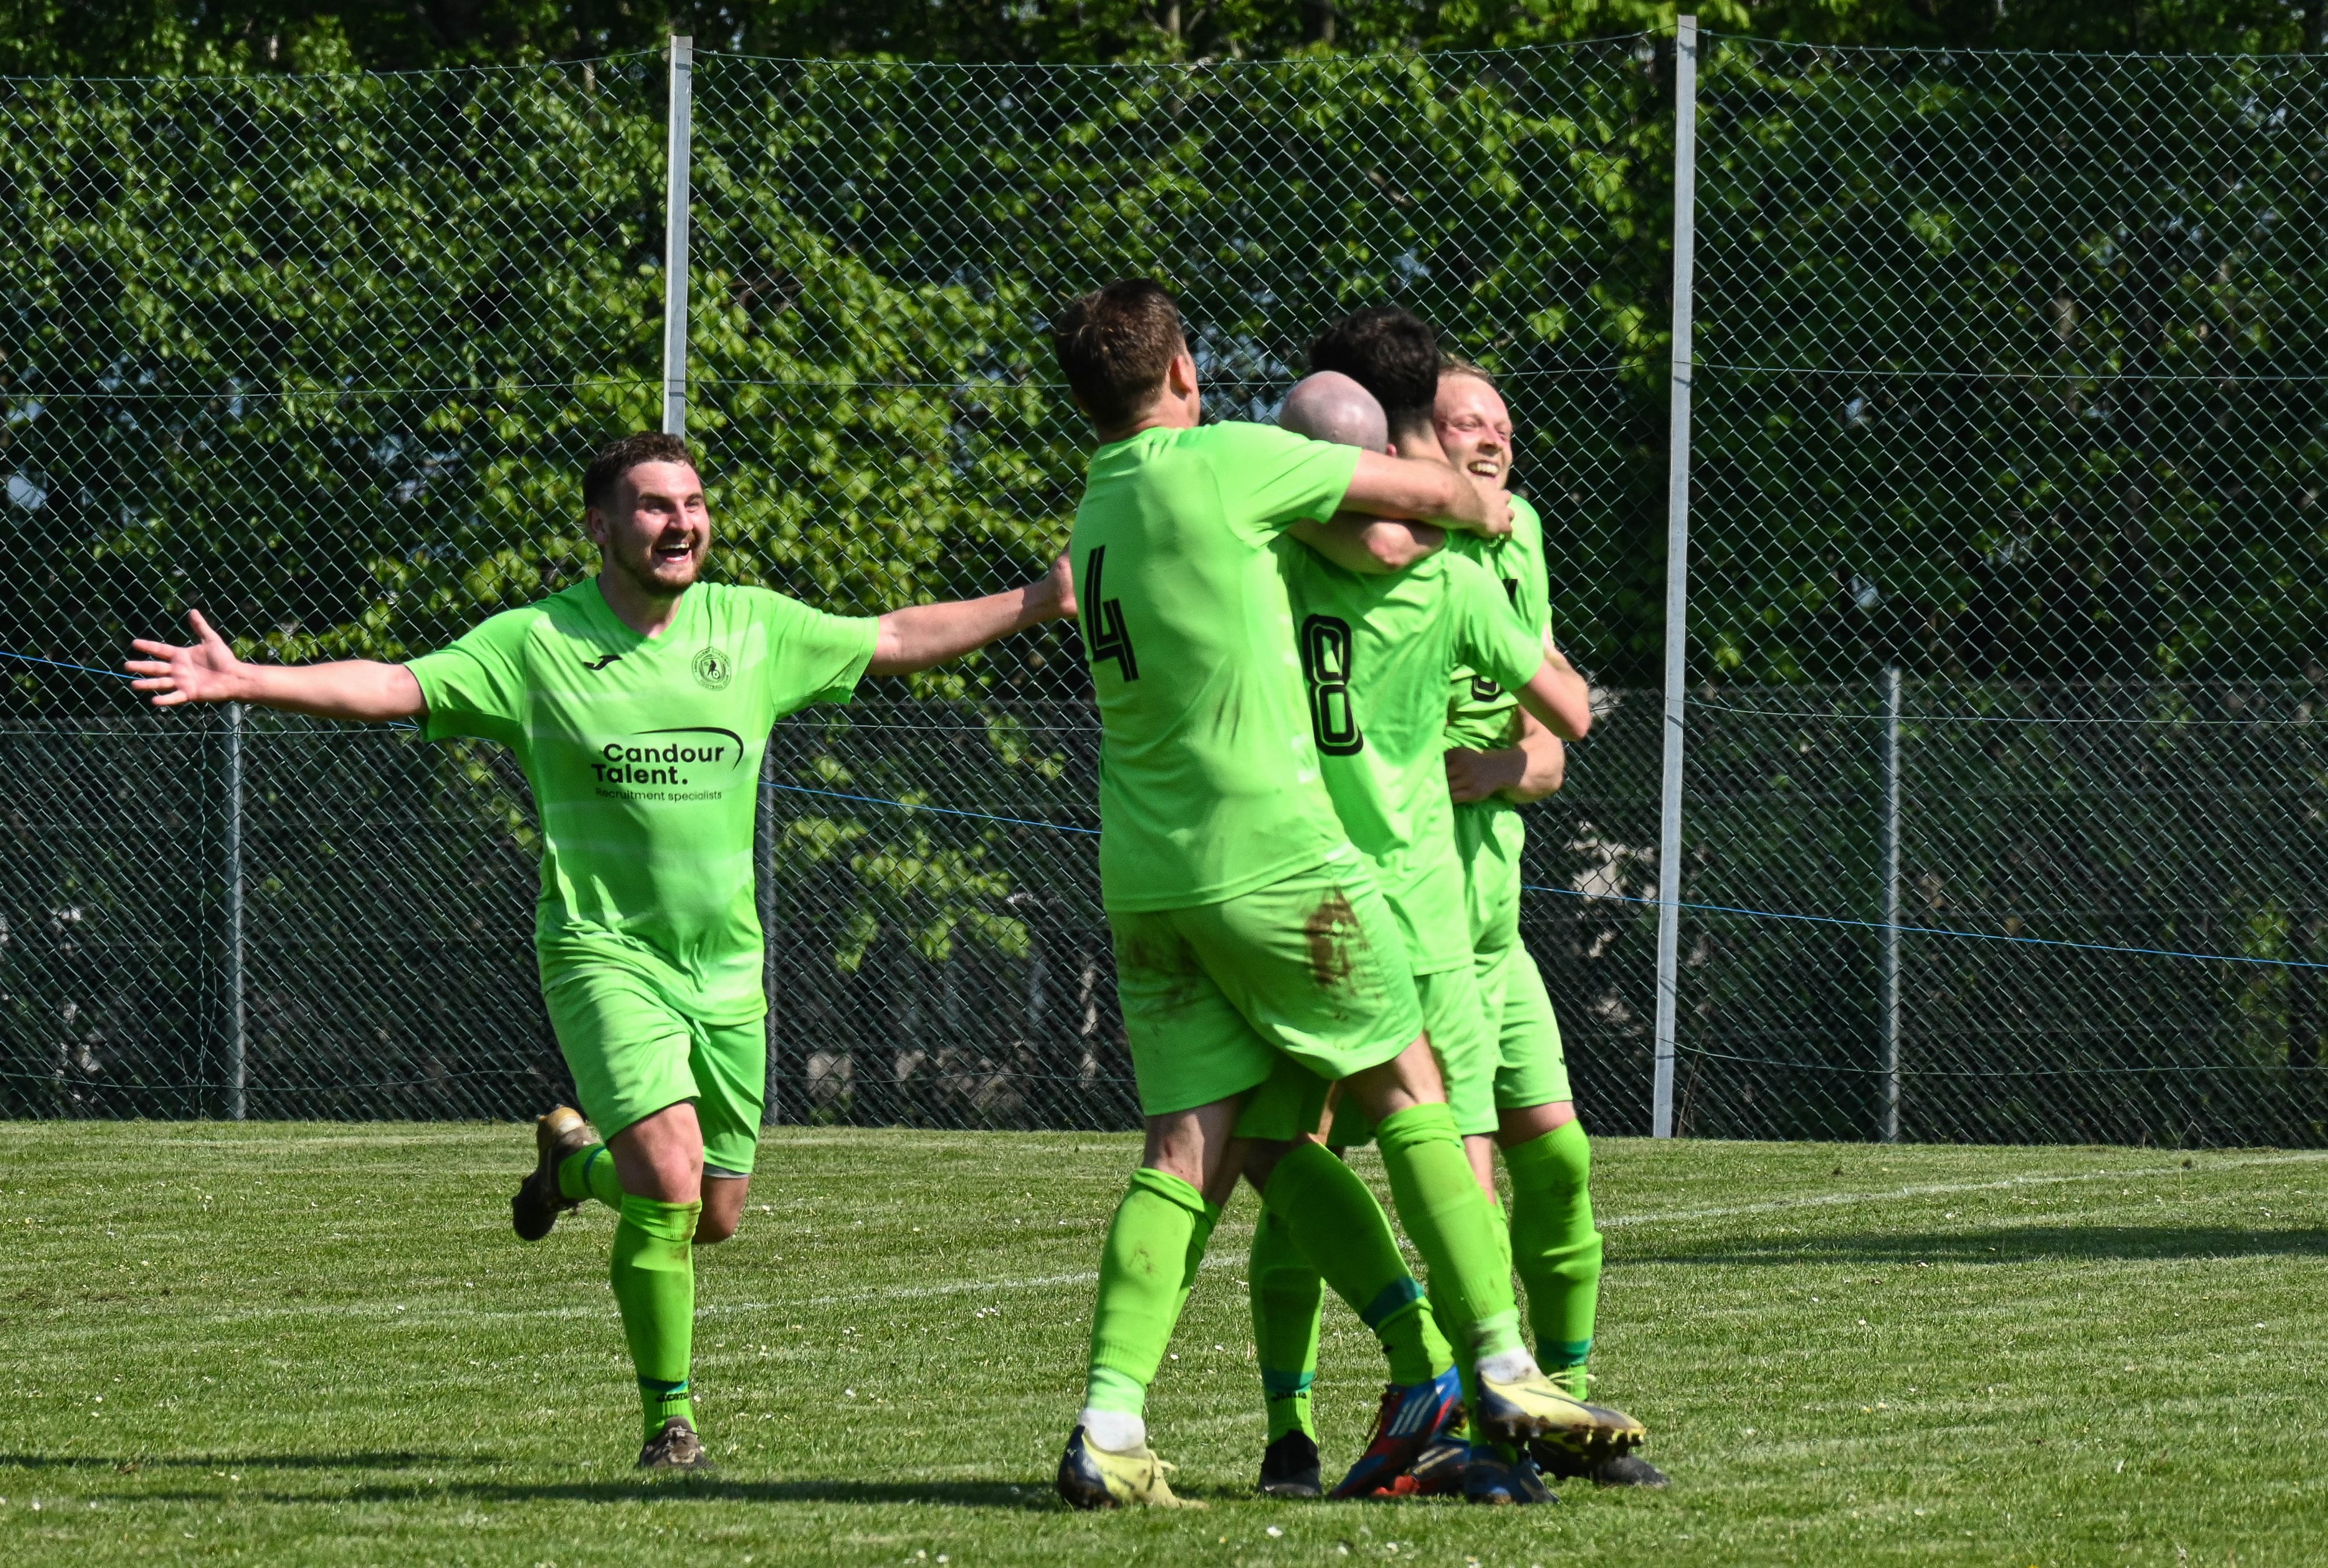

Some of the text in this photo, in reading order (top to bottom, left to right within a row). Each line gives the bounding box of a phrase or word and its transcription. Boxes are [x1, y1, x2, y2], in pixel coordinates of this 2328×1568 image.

[1084, 544, 1140, 681] 4
[1301, 613, 1364, 756] 8
[603, 743, 725, 763] Candour
[591, 764, 688, 785] Talent.
[596, 788, 722, 803] Recruitment specialists
